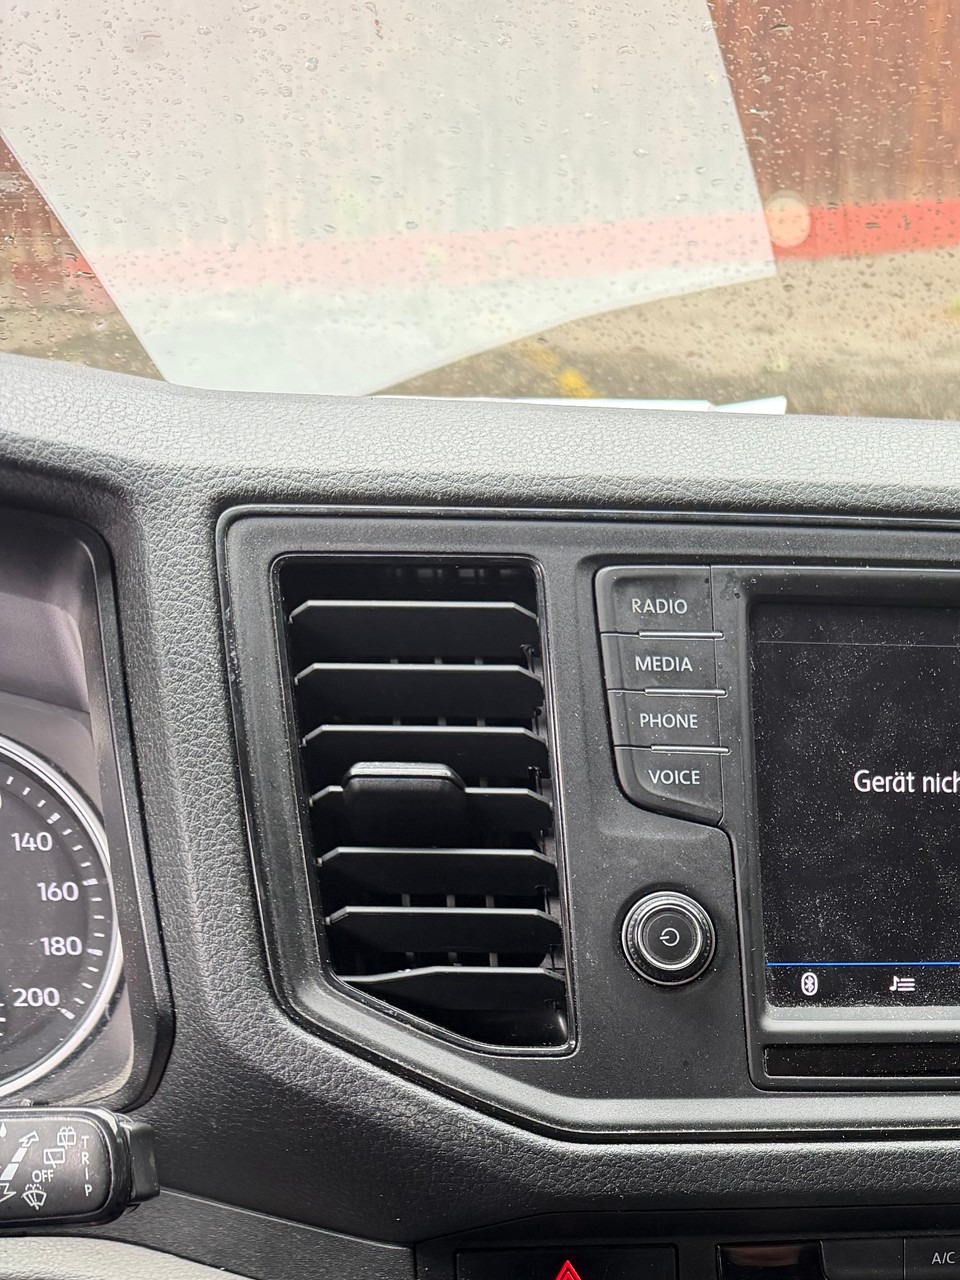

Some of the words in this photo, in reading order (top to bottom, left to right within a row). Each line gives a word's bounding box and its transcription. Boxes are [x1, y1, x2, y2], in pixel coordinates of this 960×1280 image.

[631, 598, 688, 615] RADIO
[635, 656, 693, 672] MEDIA
[639, 713, 698, 729] PHONE
[648, 769, 701, 785] VOICE
[853, 769, 915, 793] Gerät
[11, 832, 53, 852] 140
[36, 881, 80, 902] 160
[40, 936, 83, 956] 180
[12, 987, 60, 1007] 200
[81, 1135, 93, 1197] TRIP
[32, 1170, 54, 1183] OFF
[931, 1251, 956, 1265] A/C
